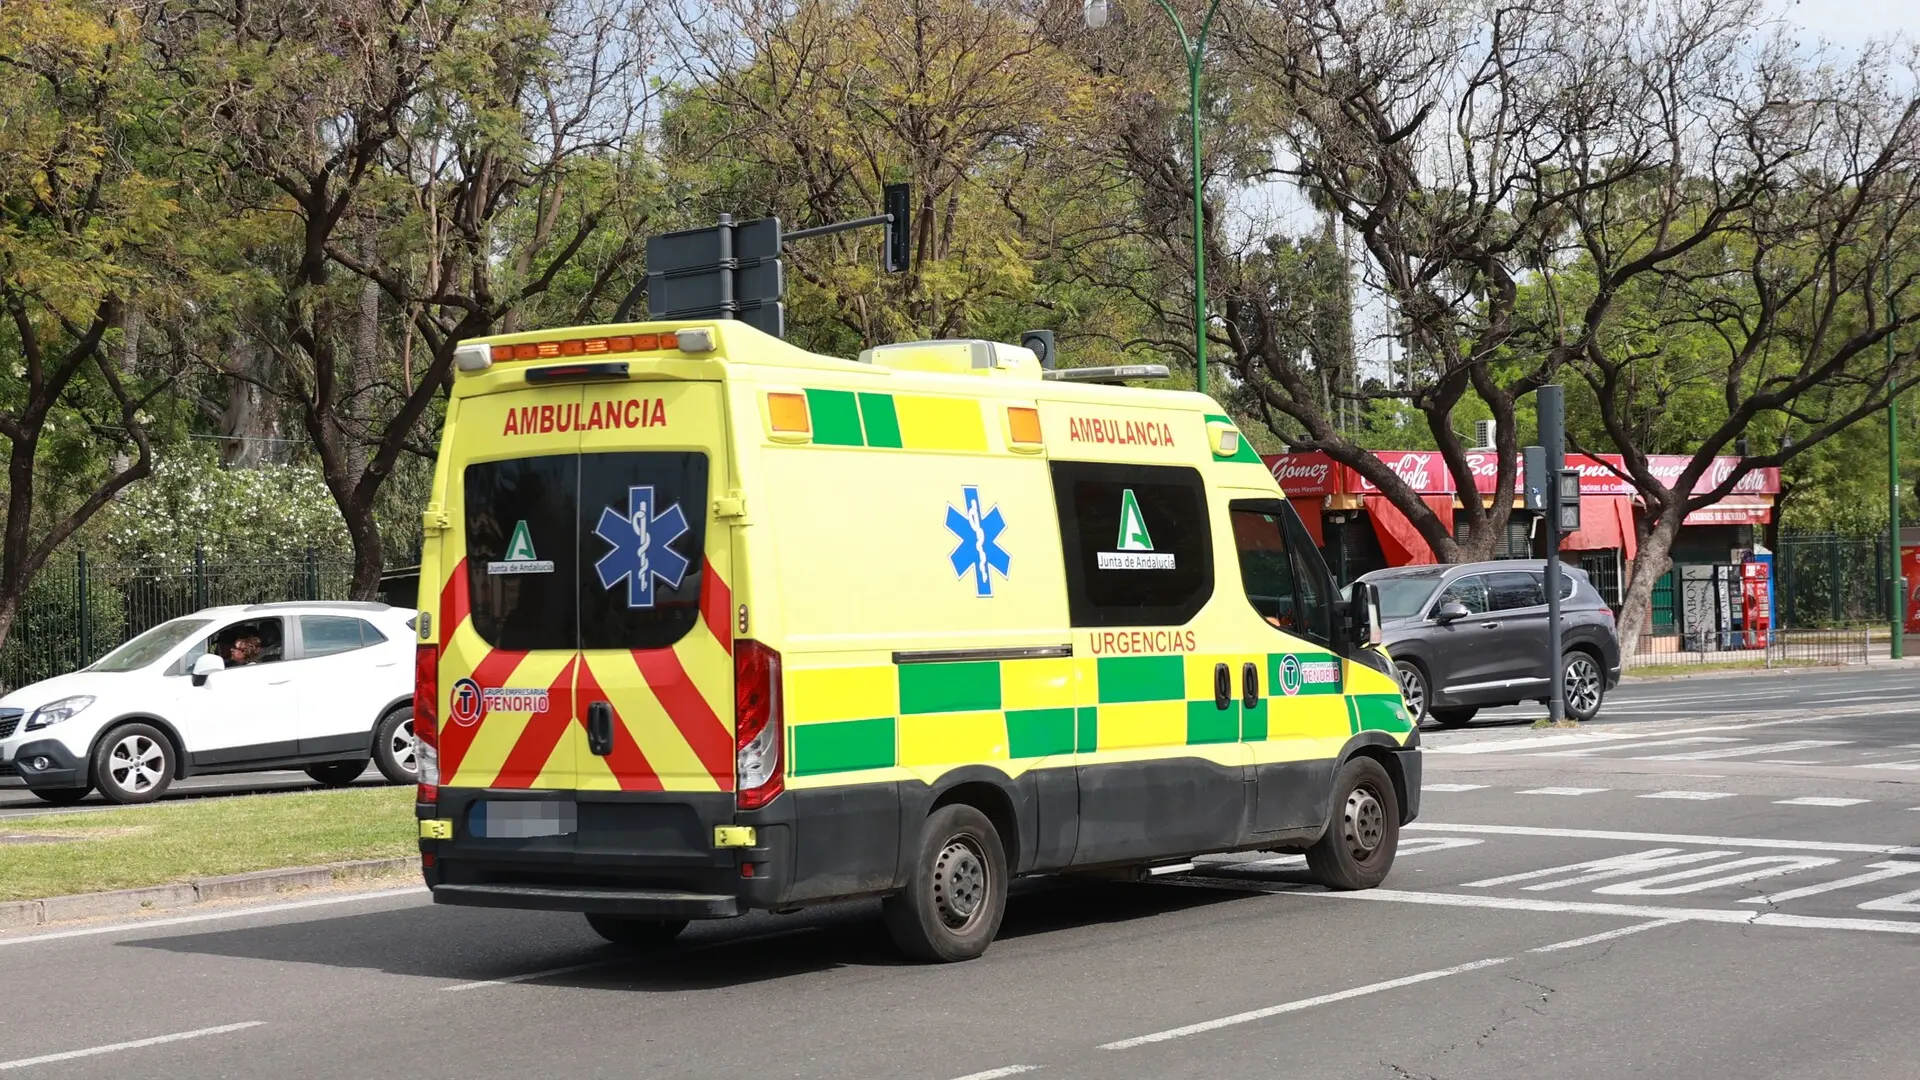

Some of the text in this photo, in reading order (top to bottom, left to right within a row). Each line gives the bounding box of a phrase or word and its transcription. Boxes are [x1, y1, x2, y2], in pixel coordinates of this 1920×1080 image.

[503, 398, 667, 436] AMBULANCIA
[1069, 416, 1175, 448] AMBULANCIA
[1271, 456, 1329, 484] Gómez
[489, 562, 554, 573] Junta de Andalucía
[1099, 555, 1175, 569] Junta de Andalucía
[1090, 630, 1197, 655] URGENCIAS
[1302, 669, 1339, 682] TENORIO
[483, 688, 504, 696] GRUPO
[484, 696, 549, 712] TENORIO
